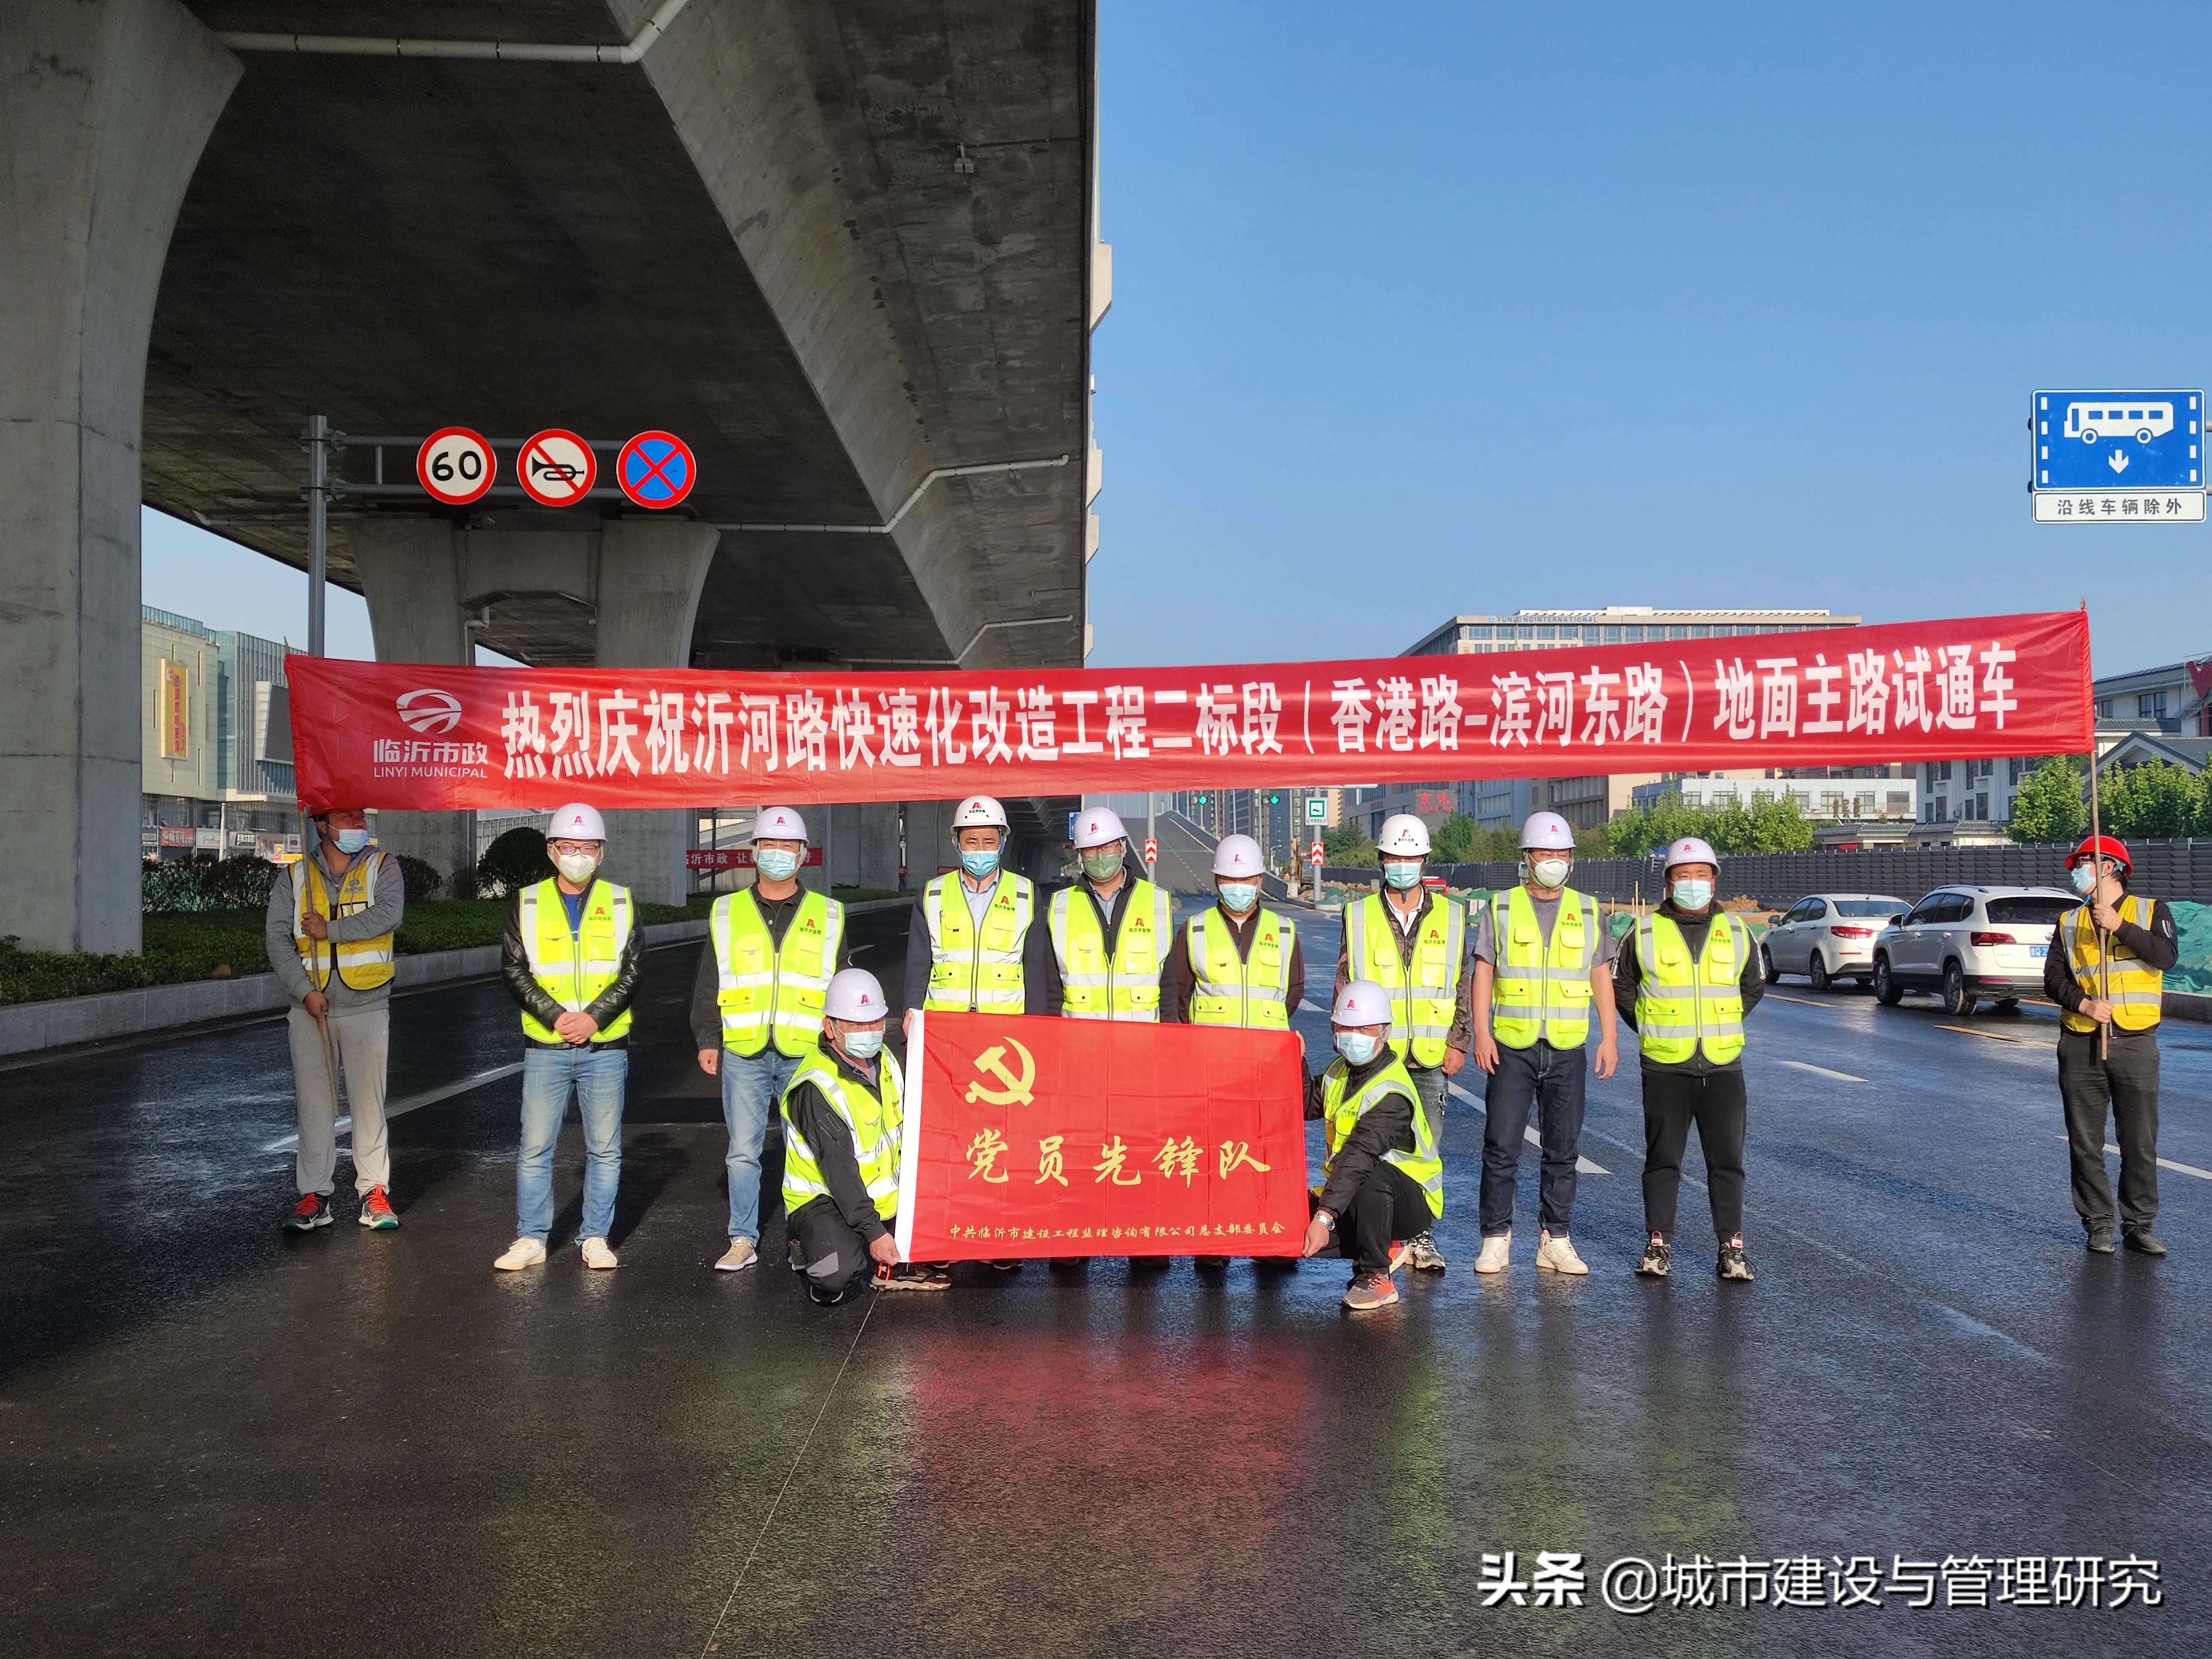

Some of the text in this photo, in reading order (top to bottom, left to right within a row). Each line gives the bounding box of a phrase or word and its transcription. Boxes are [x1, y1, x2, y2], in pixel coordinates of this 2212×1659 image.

[432, 450, 481, 481] 60
[2057, 498, 2181, 515] 沿线车辆除外
[374, 739, 488, 765] 临沂市政
[374, 766, 488, 778] LINYI MUNICIPAL
[965, 1127, 1271, 1188] 党员先锋队
[949, 1221, 1285, 1240] 中共临沂市建设工程监理咨询有限公司总支部委员会
